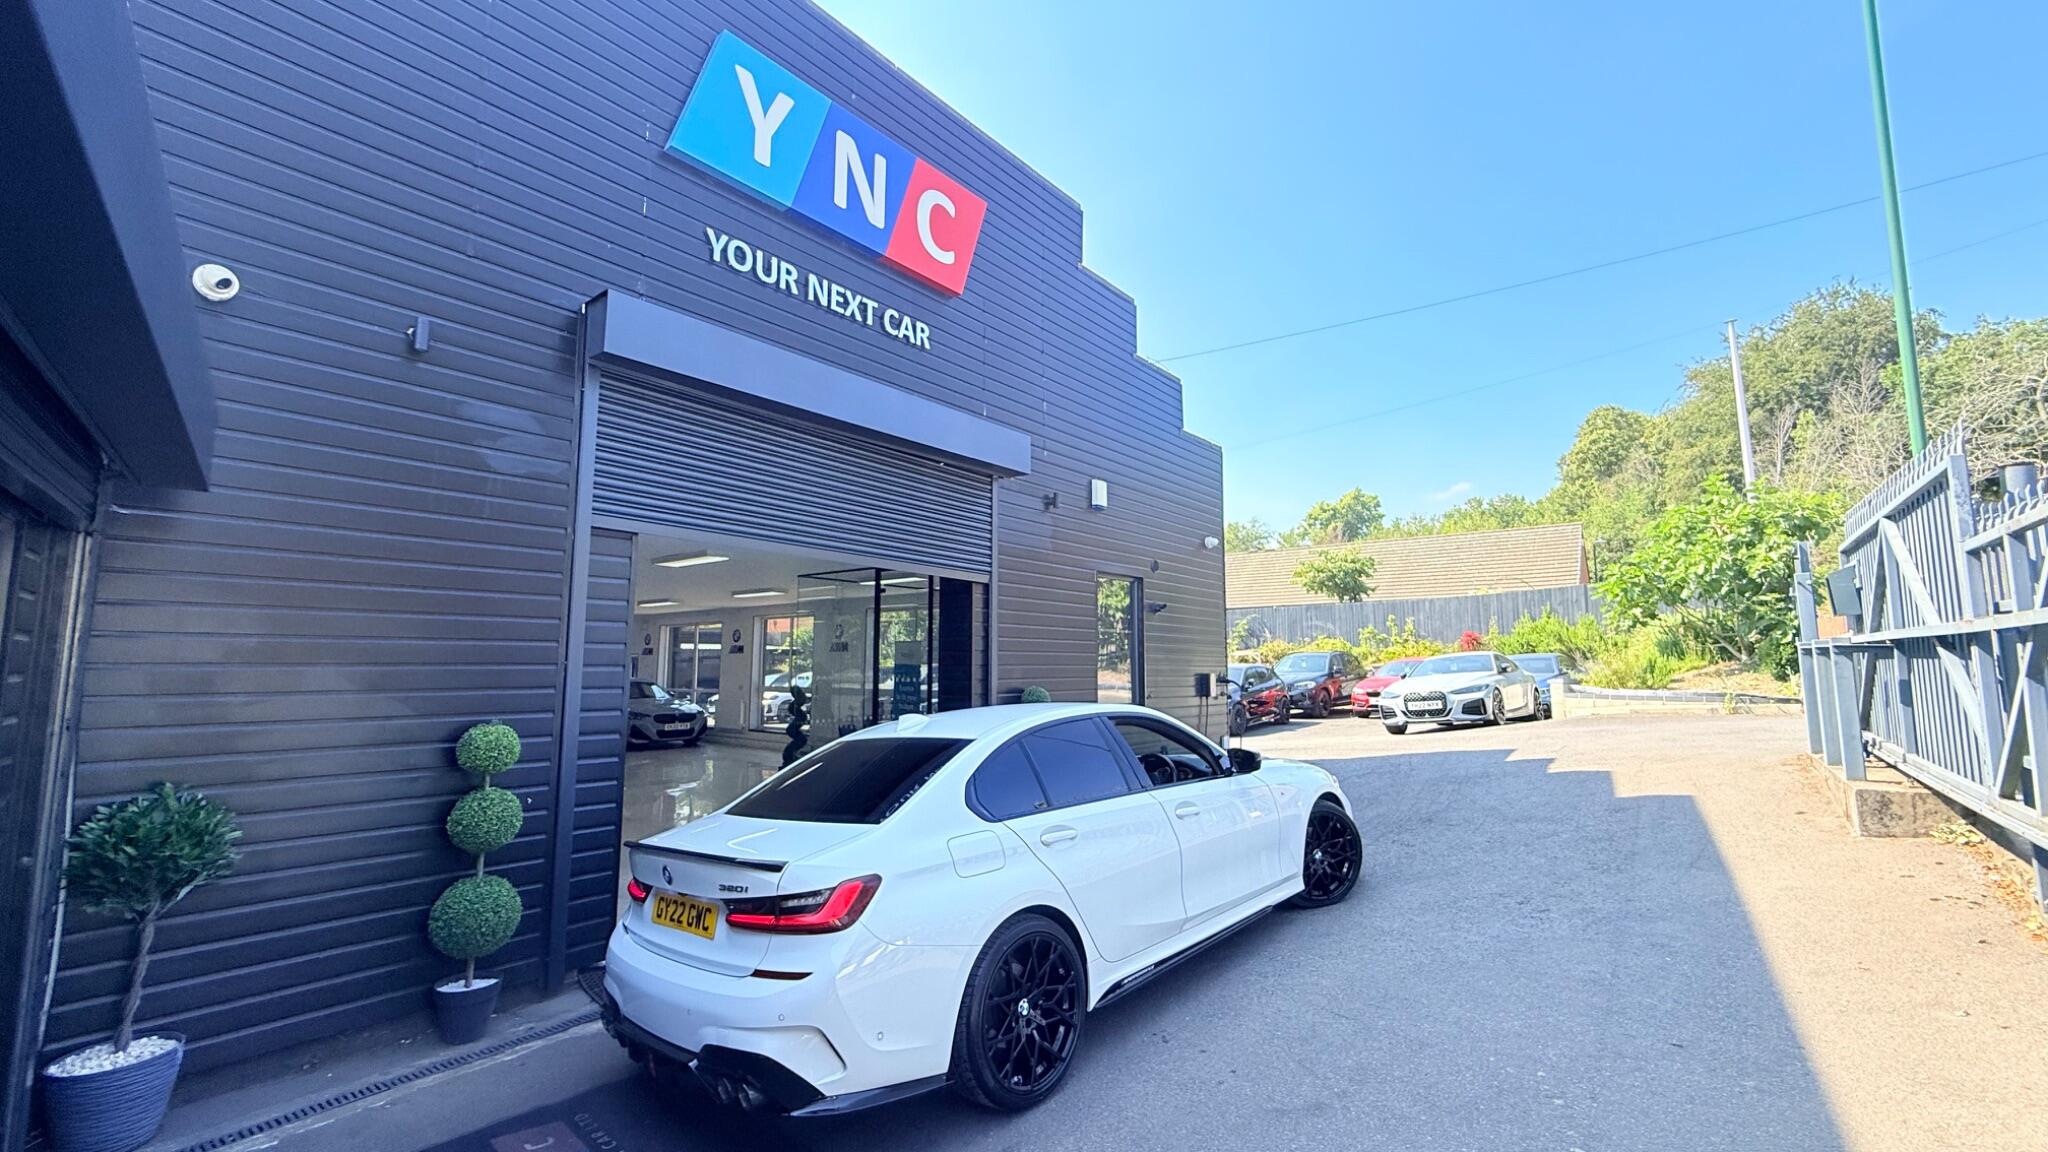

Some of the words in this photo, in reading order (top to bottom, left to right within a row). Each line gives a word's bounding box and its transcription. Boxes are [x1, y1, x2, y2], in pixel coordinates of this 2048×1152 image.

[735, 63, 956, 265] YNC
[705, 227, 799, 295] YOUR
[808, 274, 878, 326] NEXT
[883, 309, 931, 349] CAR
[656, 896, 686, 923] GY22
[687, 904, 712, 931] GWC
